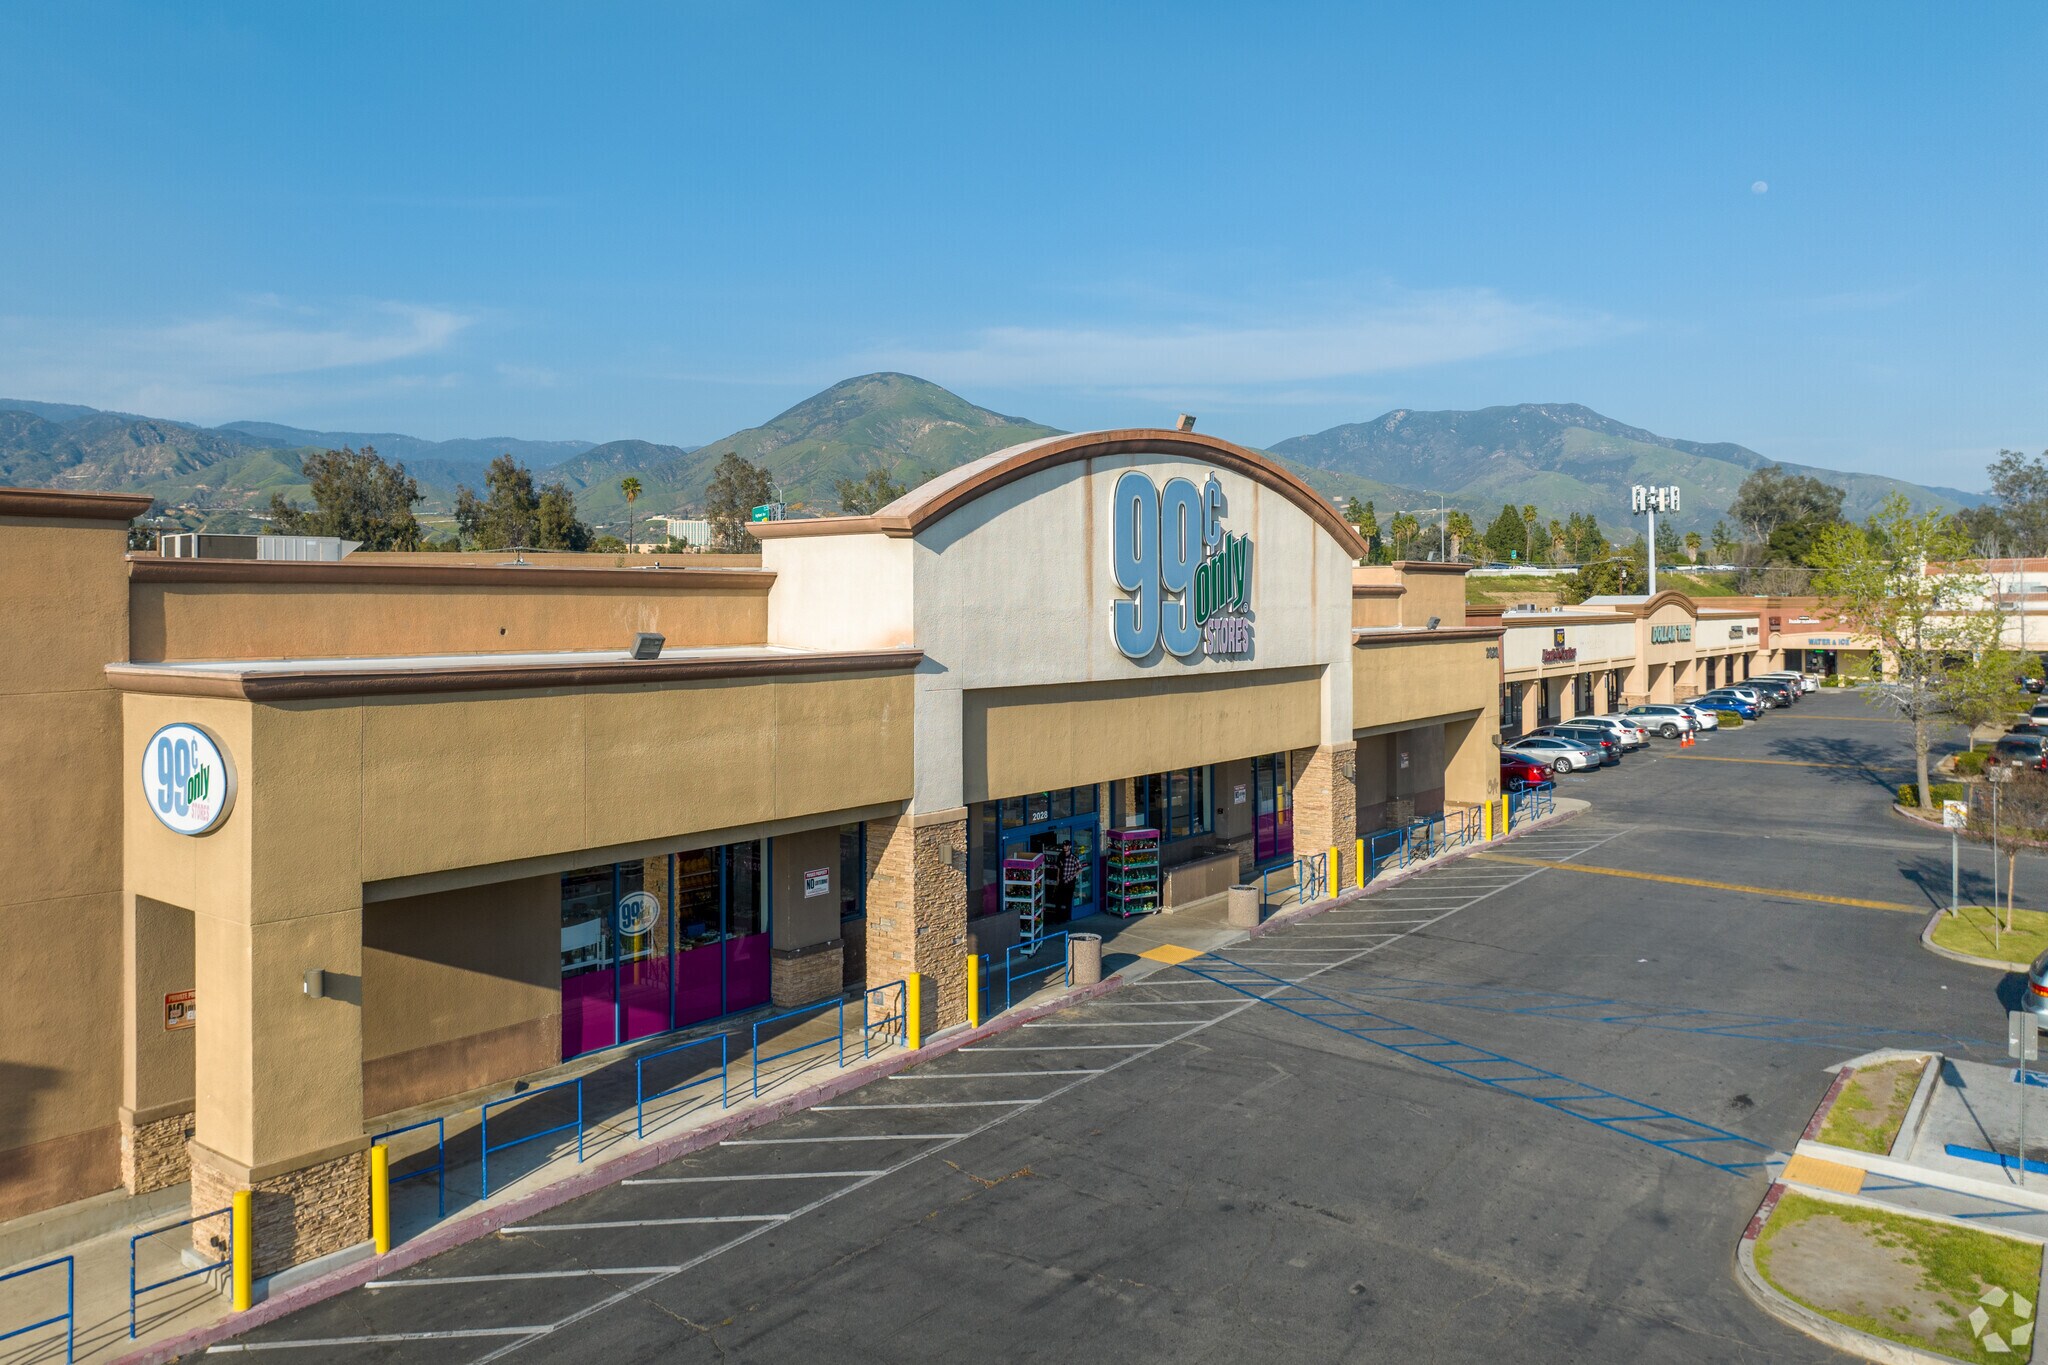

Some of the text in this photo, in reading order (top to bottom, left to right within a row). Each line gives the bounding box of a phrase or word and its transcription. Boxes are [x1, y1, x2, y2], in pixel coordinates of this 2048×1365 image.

[1194, 530, 1248, 626] only
[1207, 617, 1249, 655] STORES
[1651, 624, 1691, 643] DOLLAR TREE
[1808, 638, 1831, 646] WATER
[1838, 638, 1851, 646] ICE
[187, 763, 210, 805] only
[1032, 810, 1049, 821] 2028
[806, 879, 815, 890] NO
